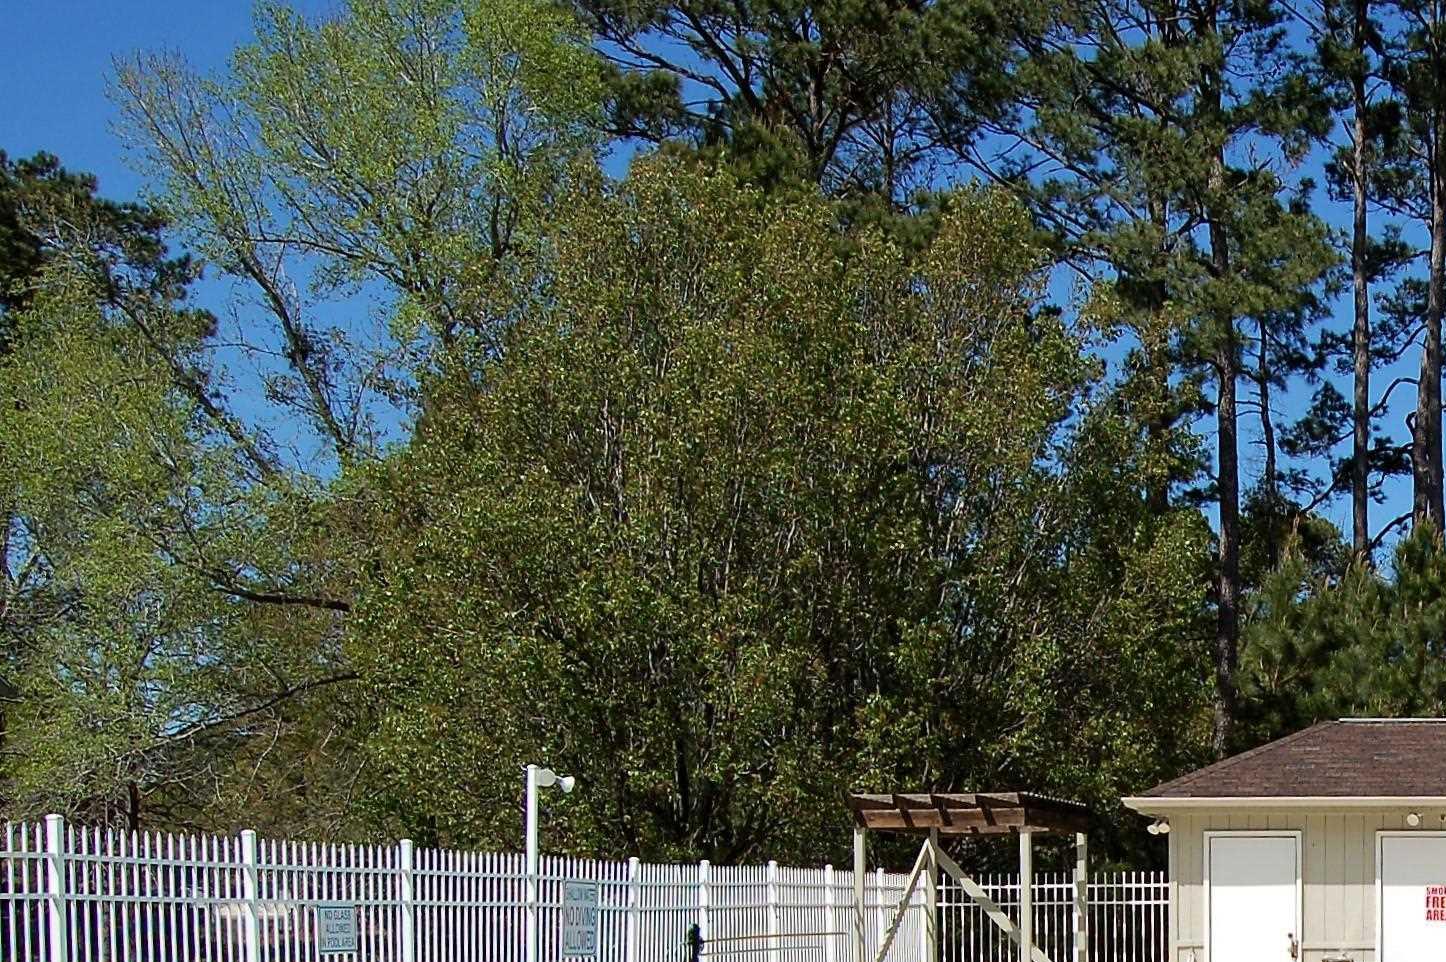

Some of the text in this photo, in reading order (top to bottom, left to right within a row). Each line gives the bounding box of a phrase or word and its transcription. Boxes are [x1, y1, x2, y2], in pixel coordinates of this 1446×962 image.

[324, 910, 352, 920] NO GLASS
[565, 906, 596, 926] NO DIVING
[326, 923, 351, 933] ALLOWED
[328, 937, 341, 948] POOL
[342, 937, 355, 948] AREA
[564, 929, 595, 950] ALLOWED
